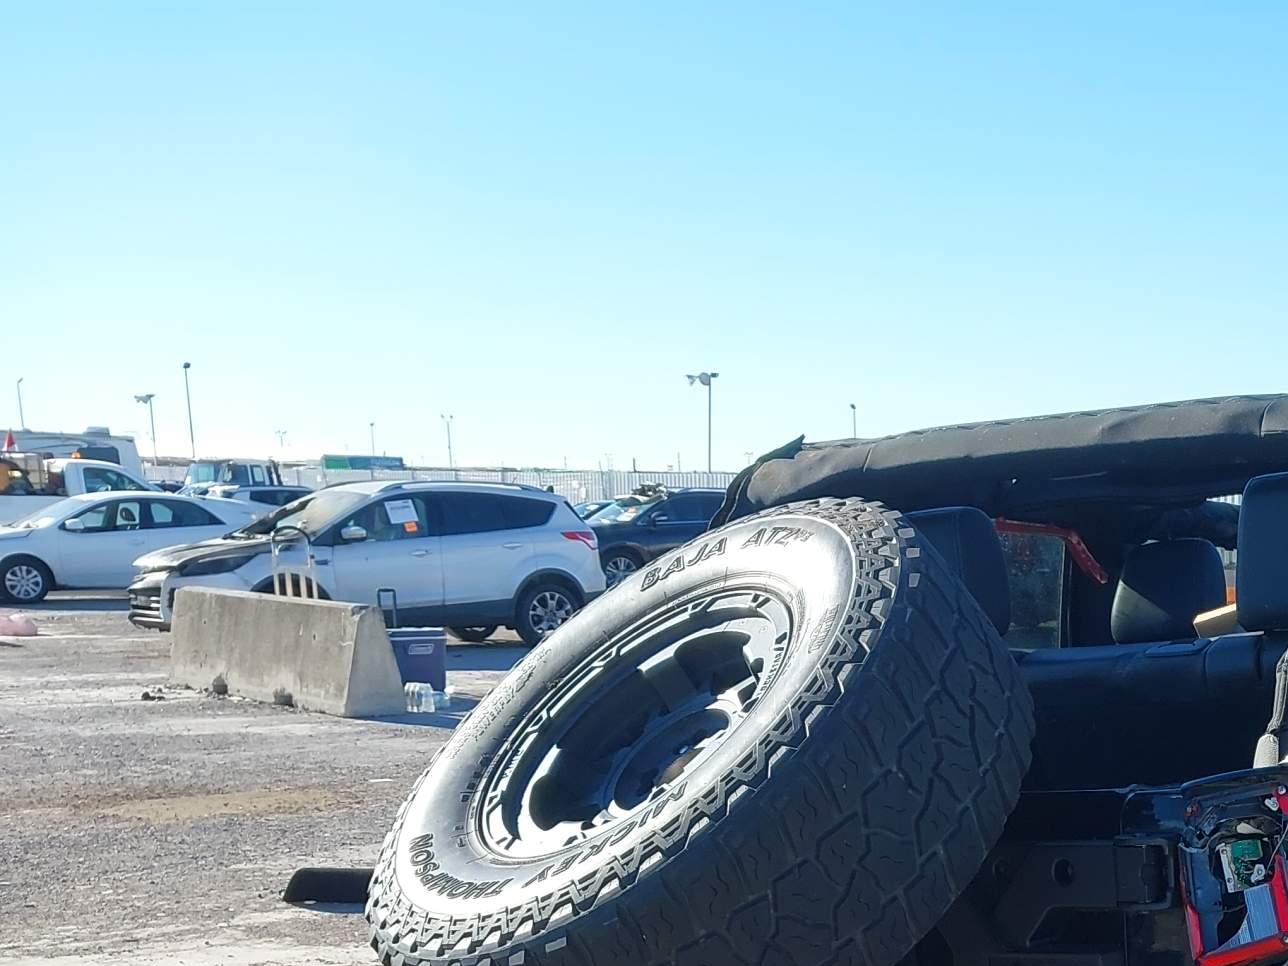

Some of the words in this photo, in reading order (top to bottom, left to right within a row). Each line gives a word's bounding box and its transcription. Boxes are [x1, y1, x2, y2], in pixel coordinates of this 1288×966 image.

[640, 537, 728, 592] BAJA
[409, 832, 514, 899] THOMPSON
[521, 781, 688, 888] MICKEY
